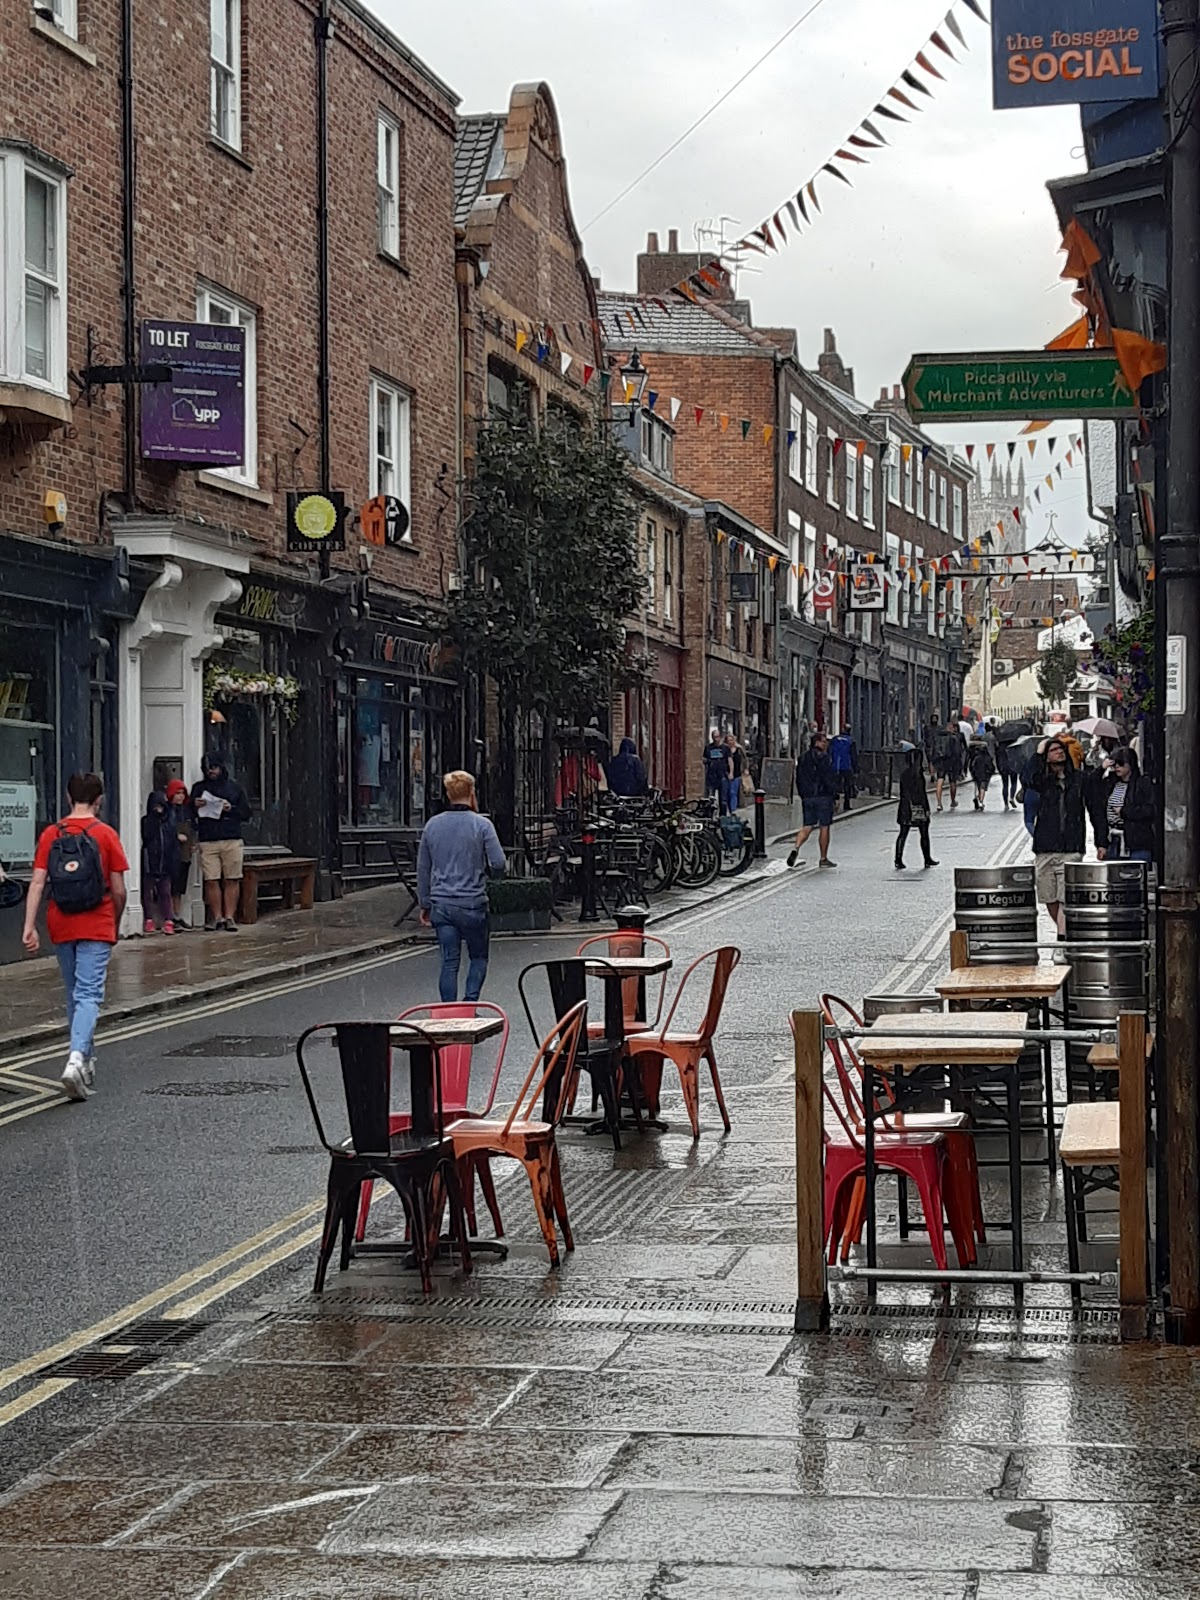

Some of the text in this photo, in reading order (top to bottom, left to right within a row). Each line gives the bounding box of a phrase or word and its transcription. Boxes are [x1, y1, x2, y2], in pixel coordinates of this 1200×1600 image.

[1006, 26, 1139, 50] the fossgate
[1007, 47, 1143, 84] SOCIAL
[148, 329, 190, 348] TO LET
[224, 342, 241, 352] HOUSE
[964, 369, 1067, 386] Piccadilly via
[928, 386, 1105, 403] Merchant Adventurers
[194, 408, 221, 423] ypp
[289, 540, 344, 551] COFFEE
[240, 585, 279, 620] SPRING
[988, 893, 1026, 907] Kegstar
